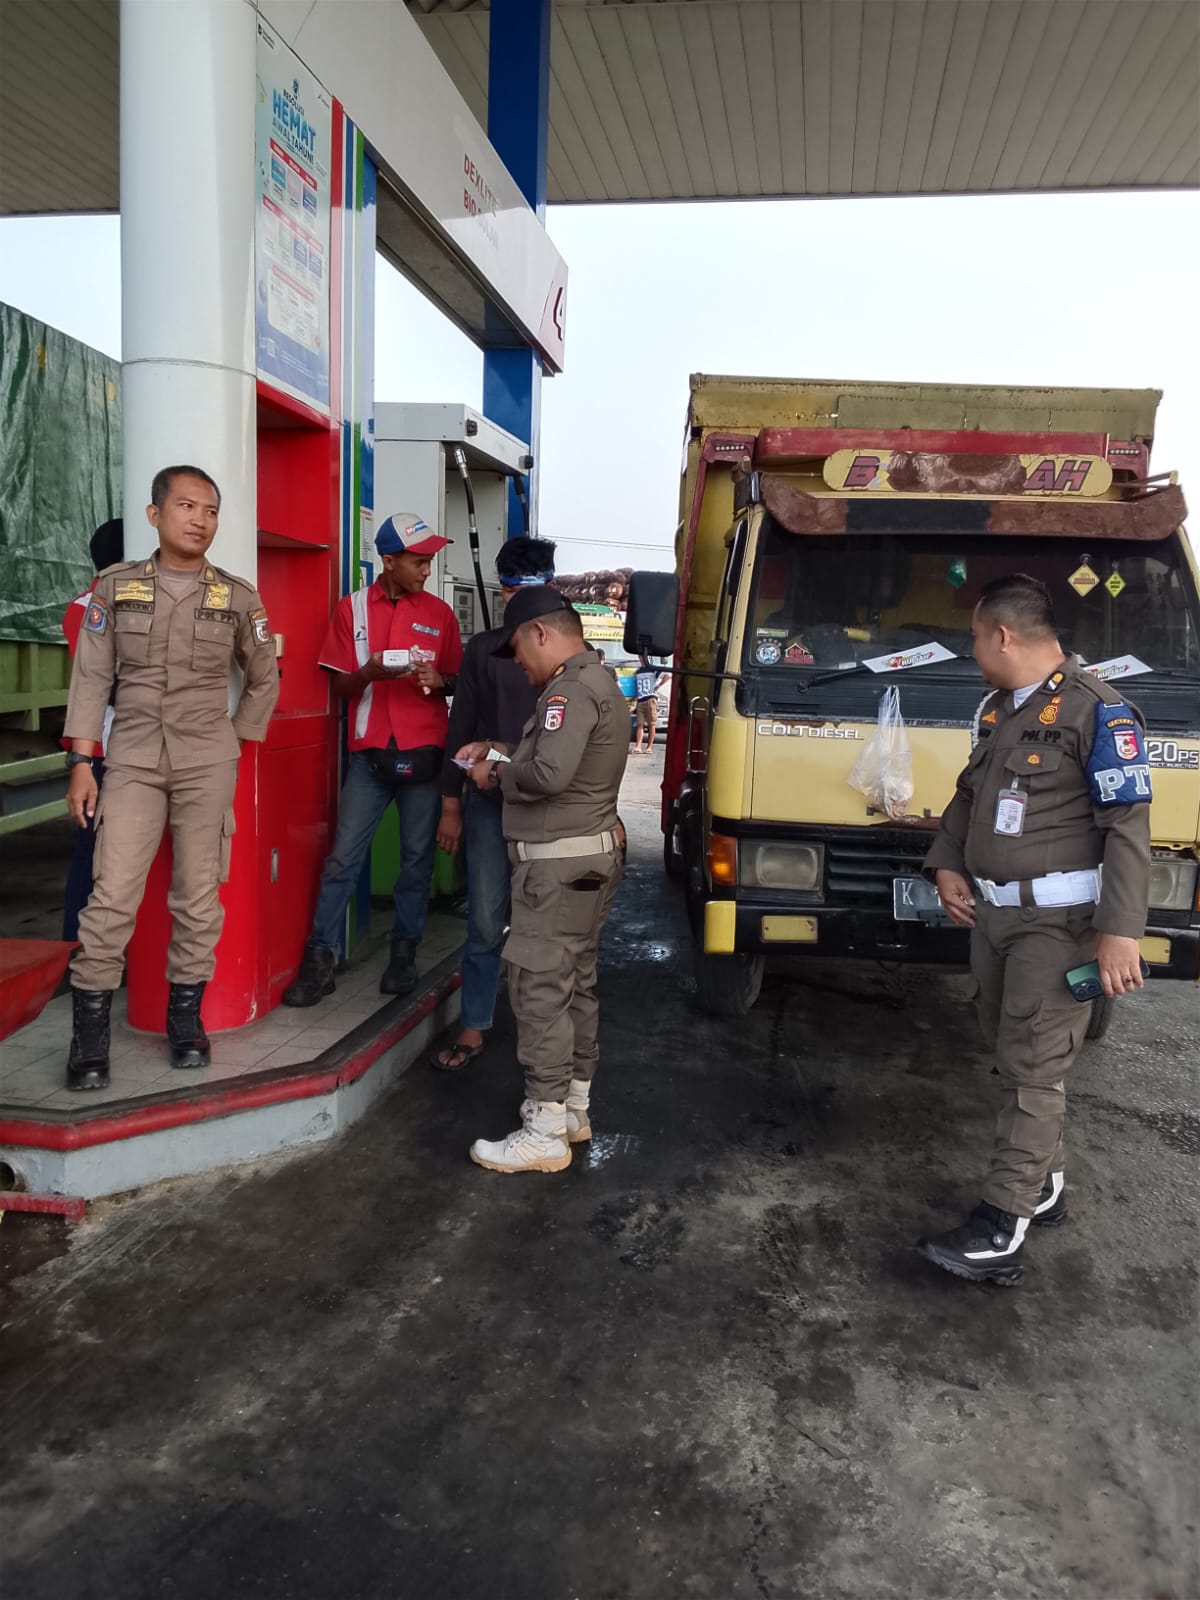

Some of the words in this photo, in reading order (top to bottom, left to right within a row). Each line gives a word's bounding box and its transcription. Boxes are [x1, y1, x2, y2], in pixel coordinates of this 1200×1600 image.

[272, 88, 316, 152] HEMAT
[464, 153, 499, 218] DEXLITE
[464, 188, 477, 216] BIO
[1043, 730, 1061, 743] PP
